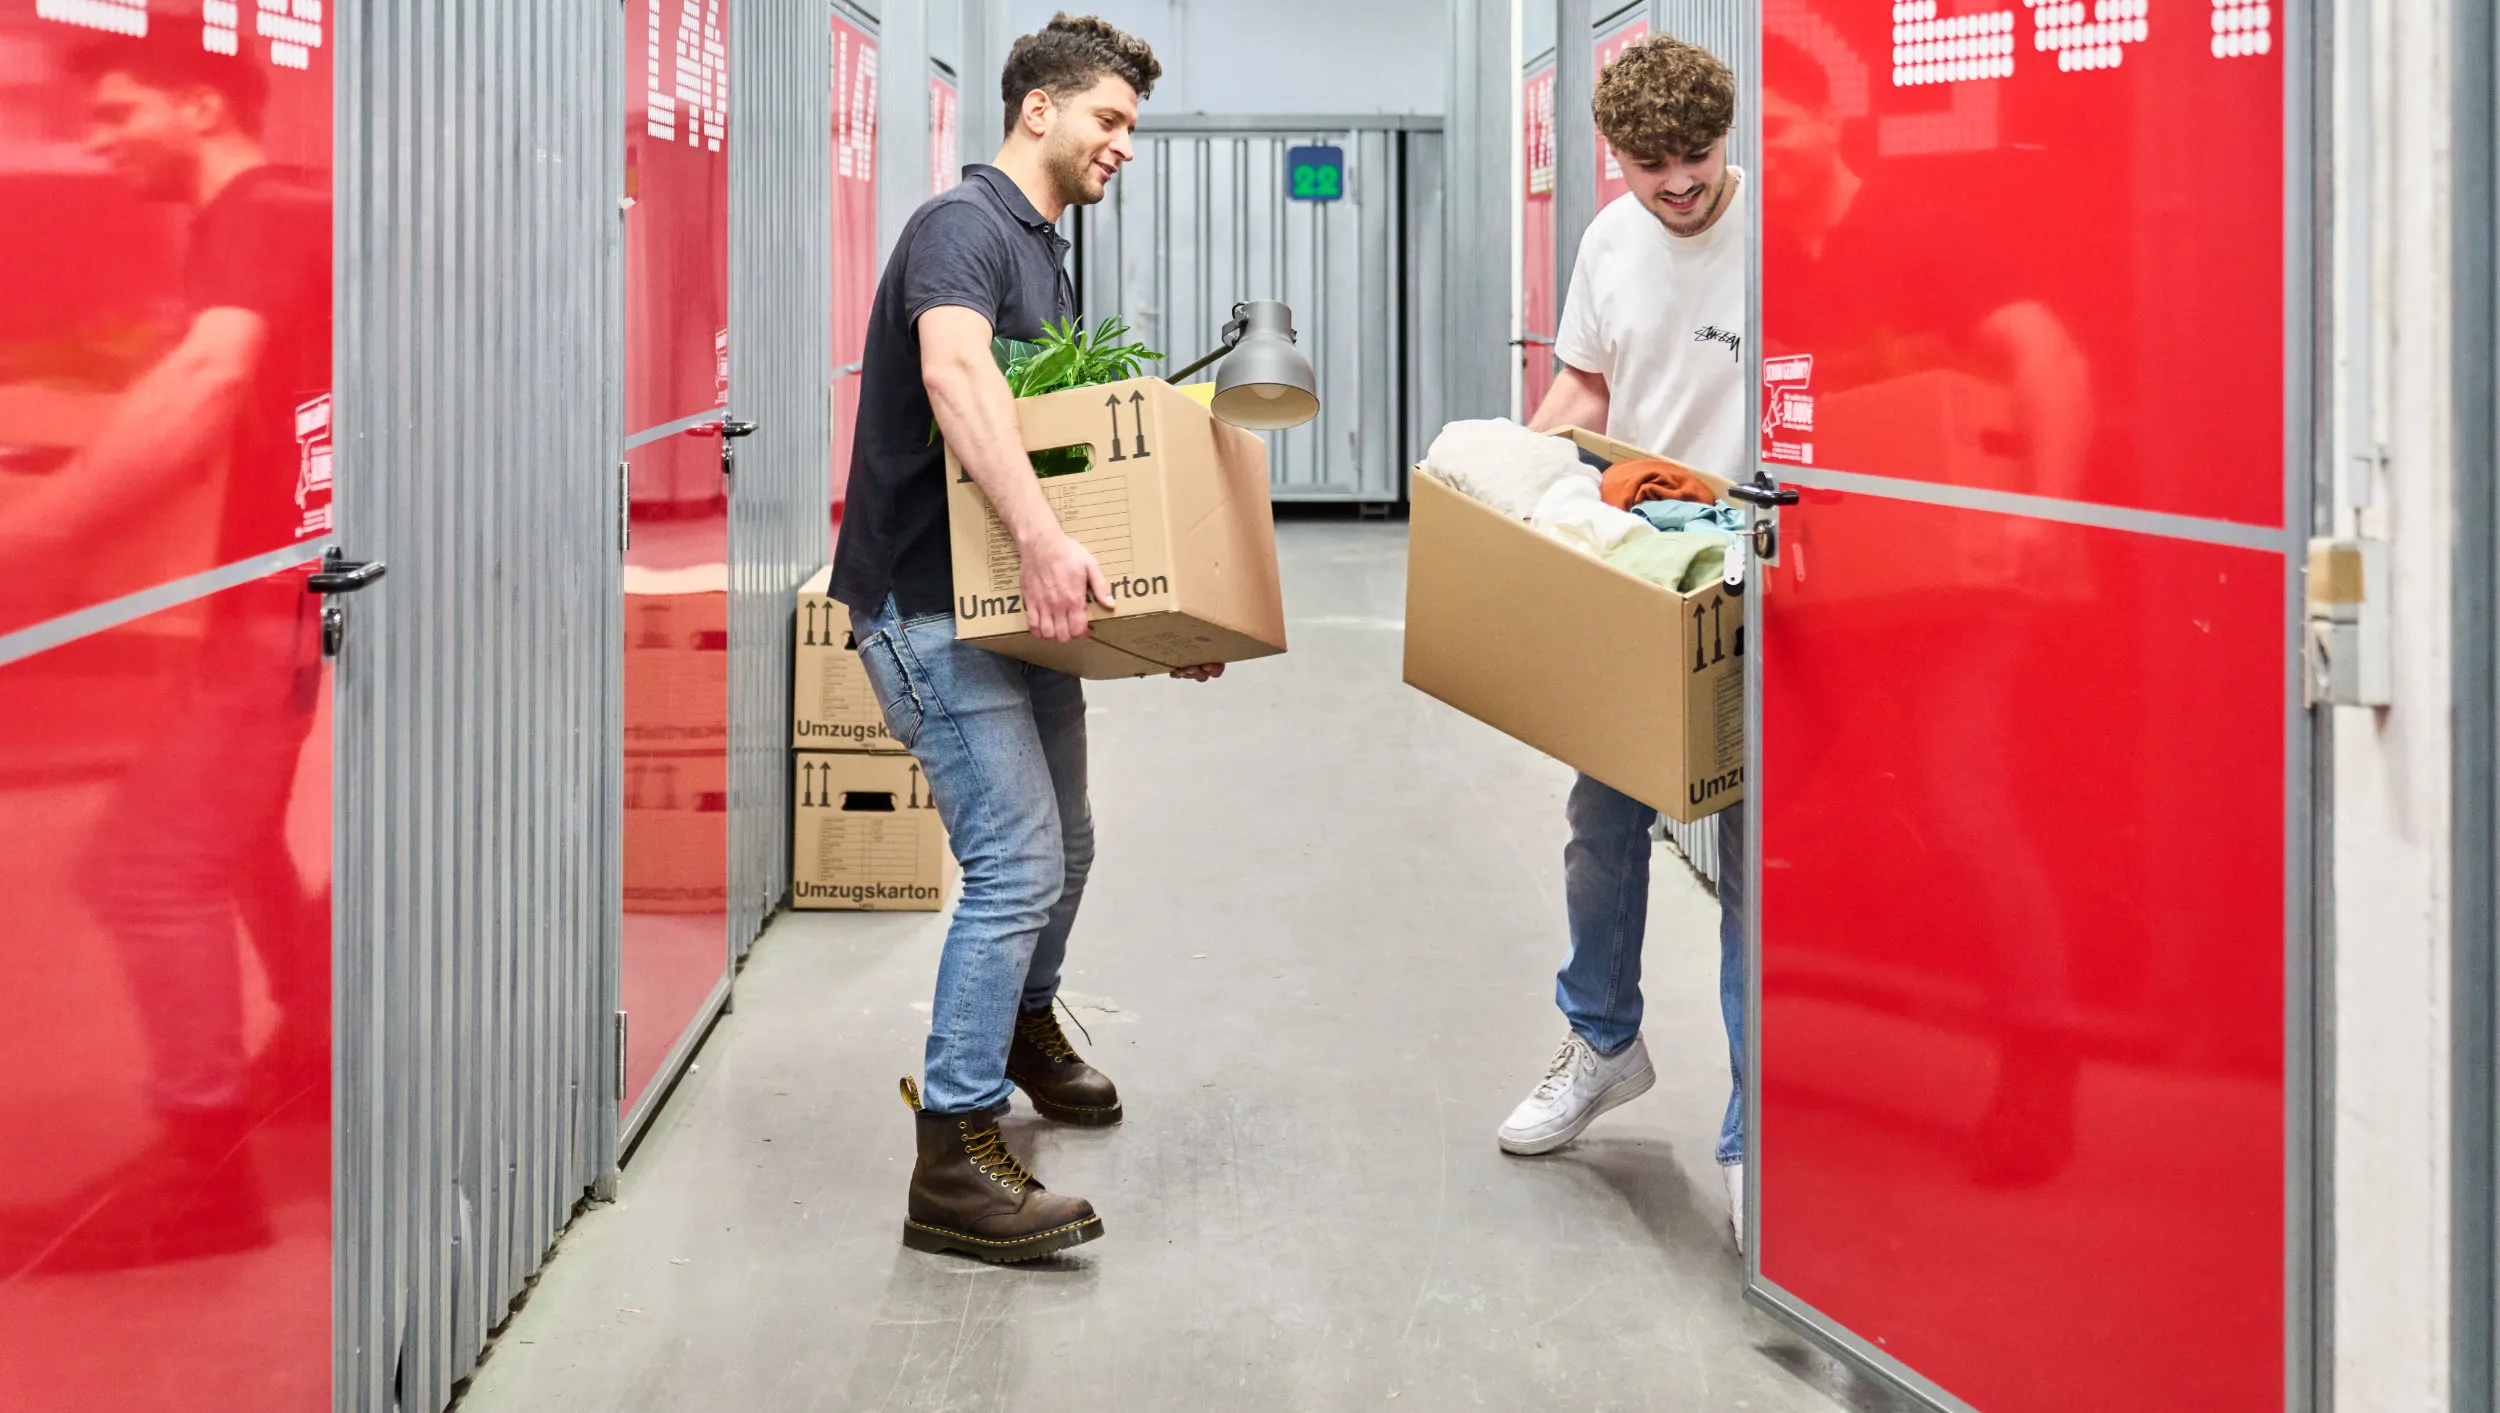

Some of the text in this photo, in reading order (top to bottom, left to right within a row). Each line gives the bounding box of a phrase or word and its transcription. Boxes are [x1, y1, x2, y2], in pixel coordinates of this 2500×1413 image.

[1293, 163, 1340, 197] 22
[797, 720, 891, 742] Umzugsk
[795, 881, 940, 903] Umzugskarton
